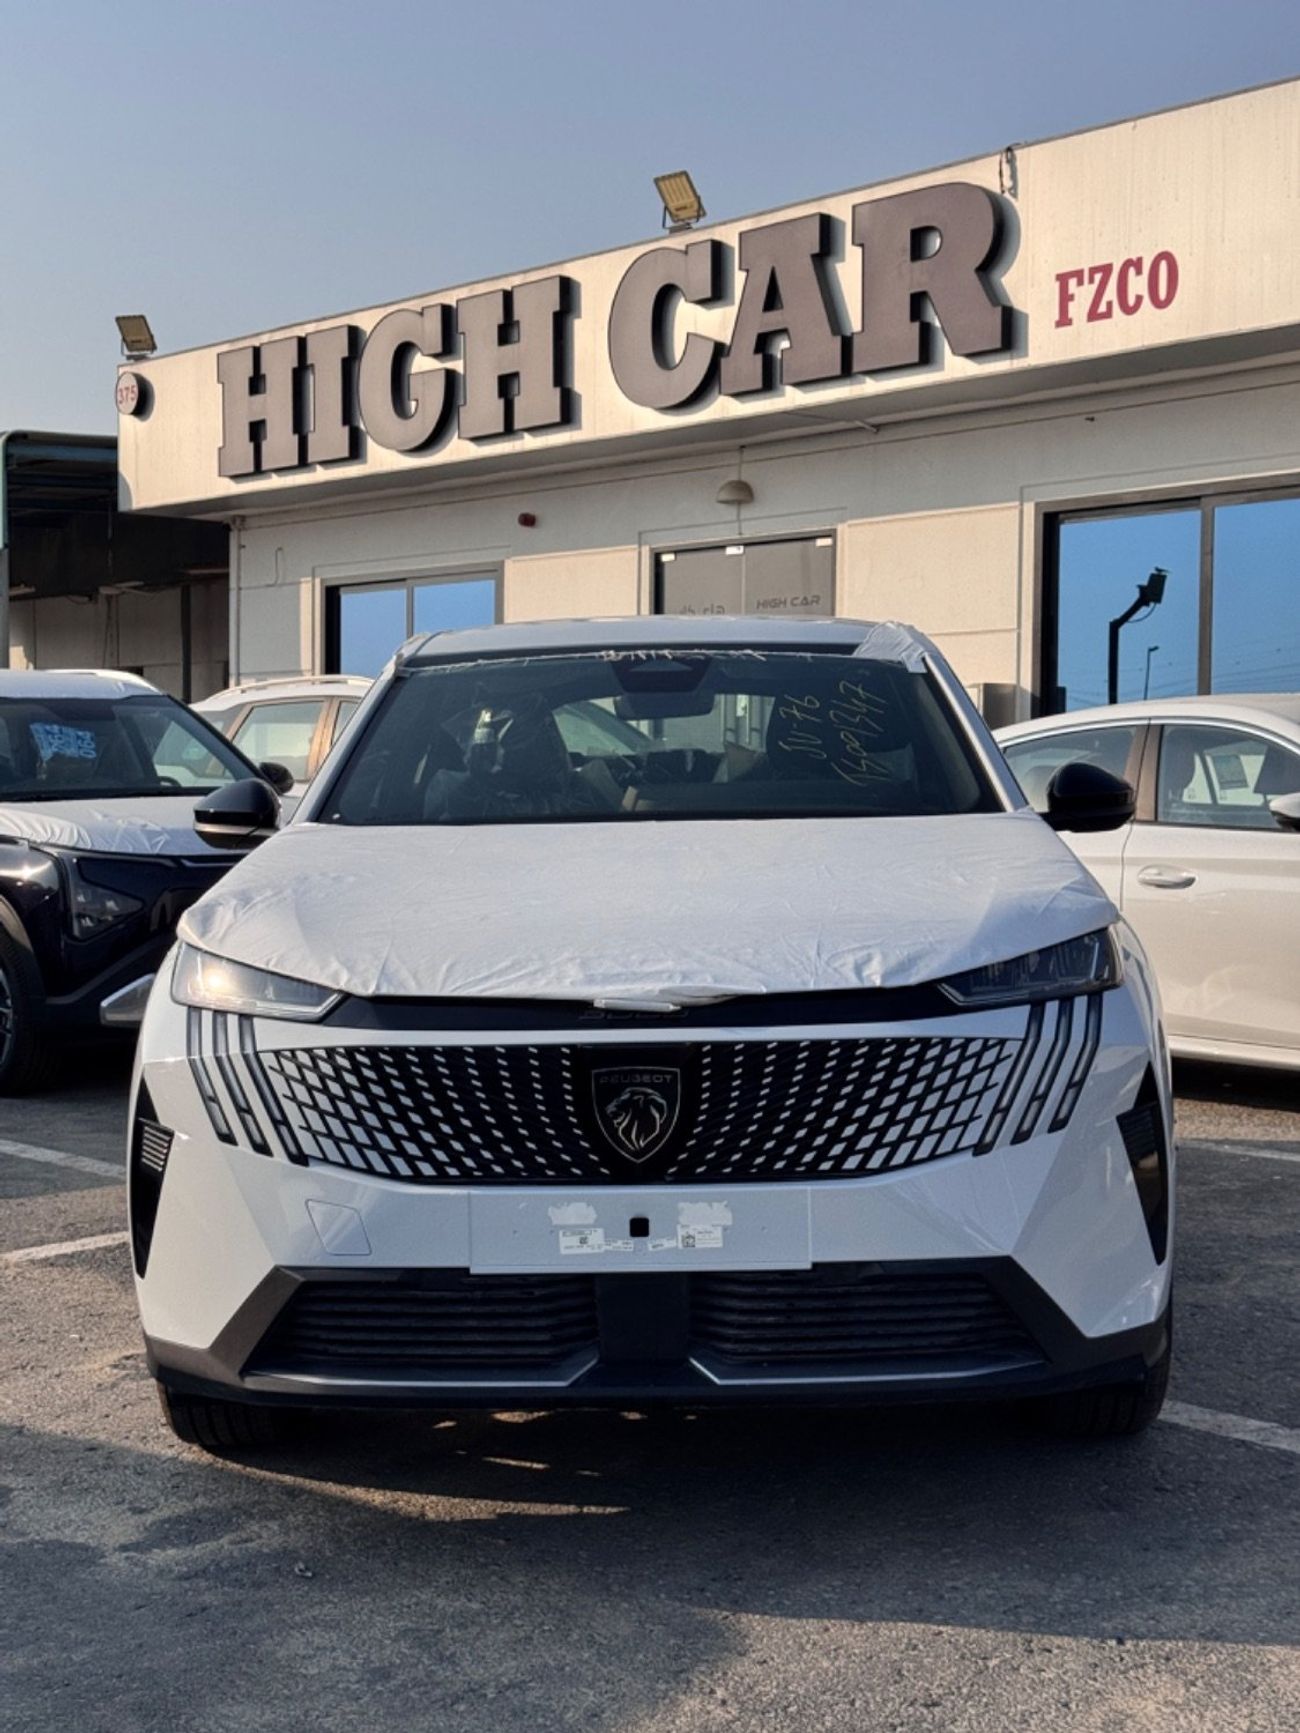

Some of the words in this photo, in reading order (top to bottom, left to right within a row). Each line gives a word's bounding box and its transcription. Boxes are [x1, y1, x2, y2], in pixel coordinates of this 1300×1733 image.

[1054, 250, 1179, 329] FZCO
[217, 274, 571, 478] HIGH
[607, 181, 1013, 409] CAR
[118, 384, 137, 404] 375
[756, 597, 787, 610] HIGH
[790, 594, 821, 607] CAR
[599, 1074, 673, 1083] PEUGEOT
